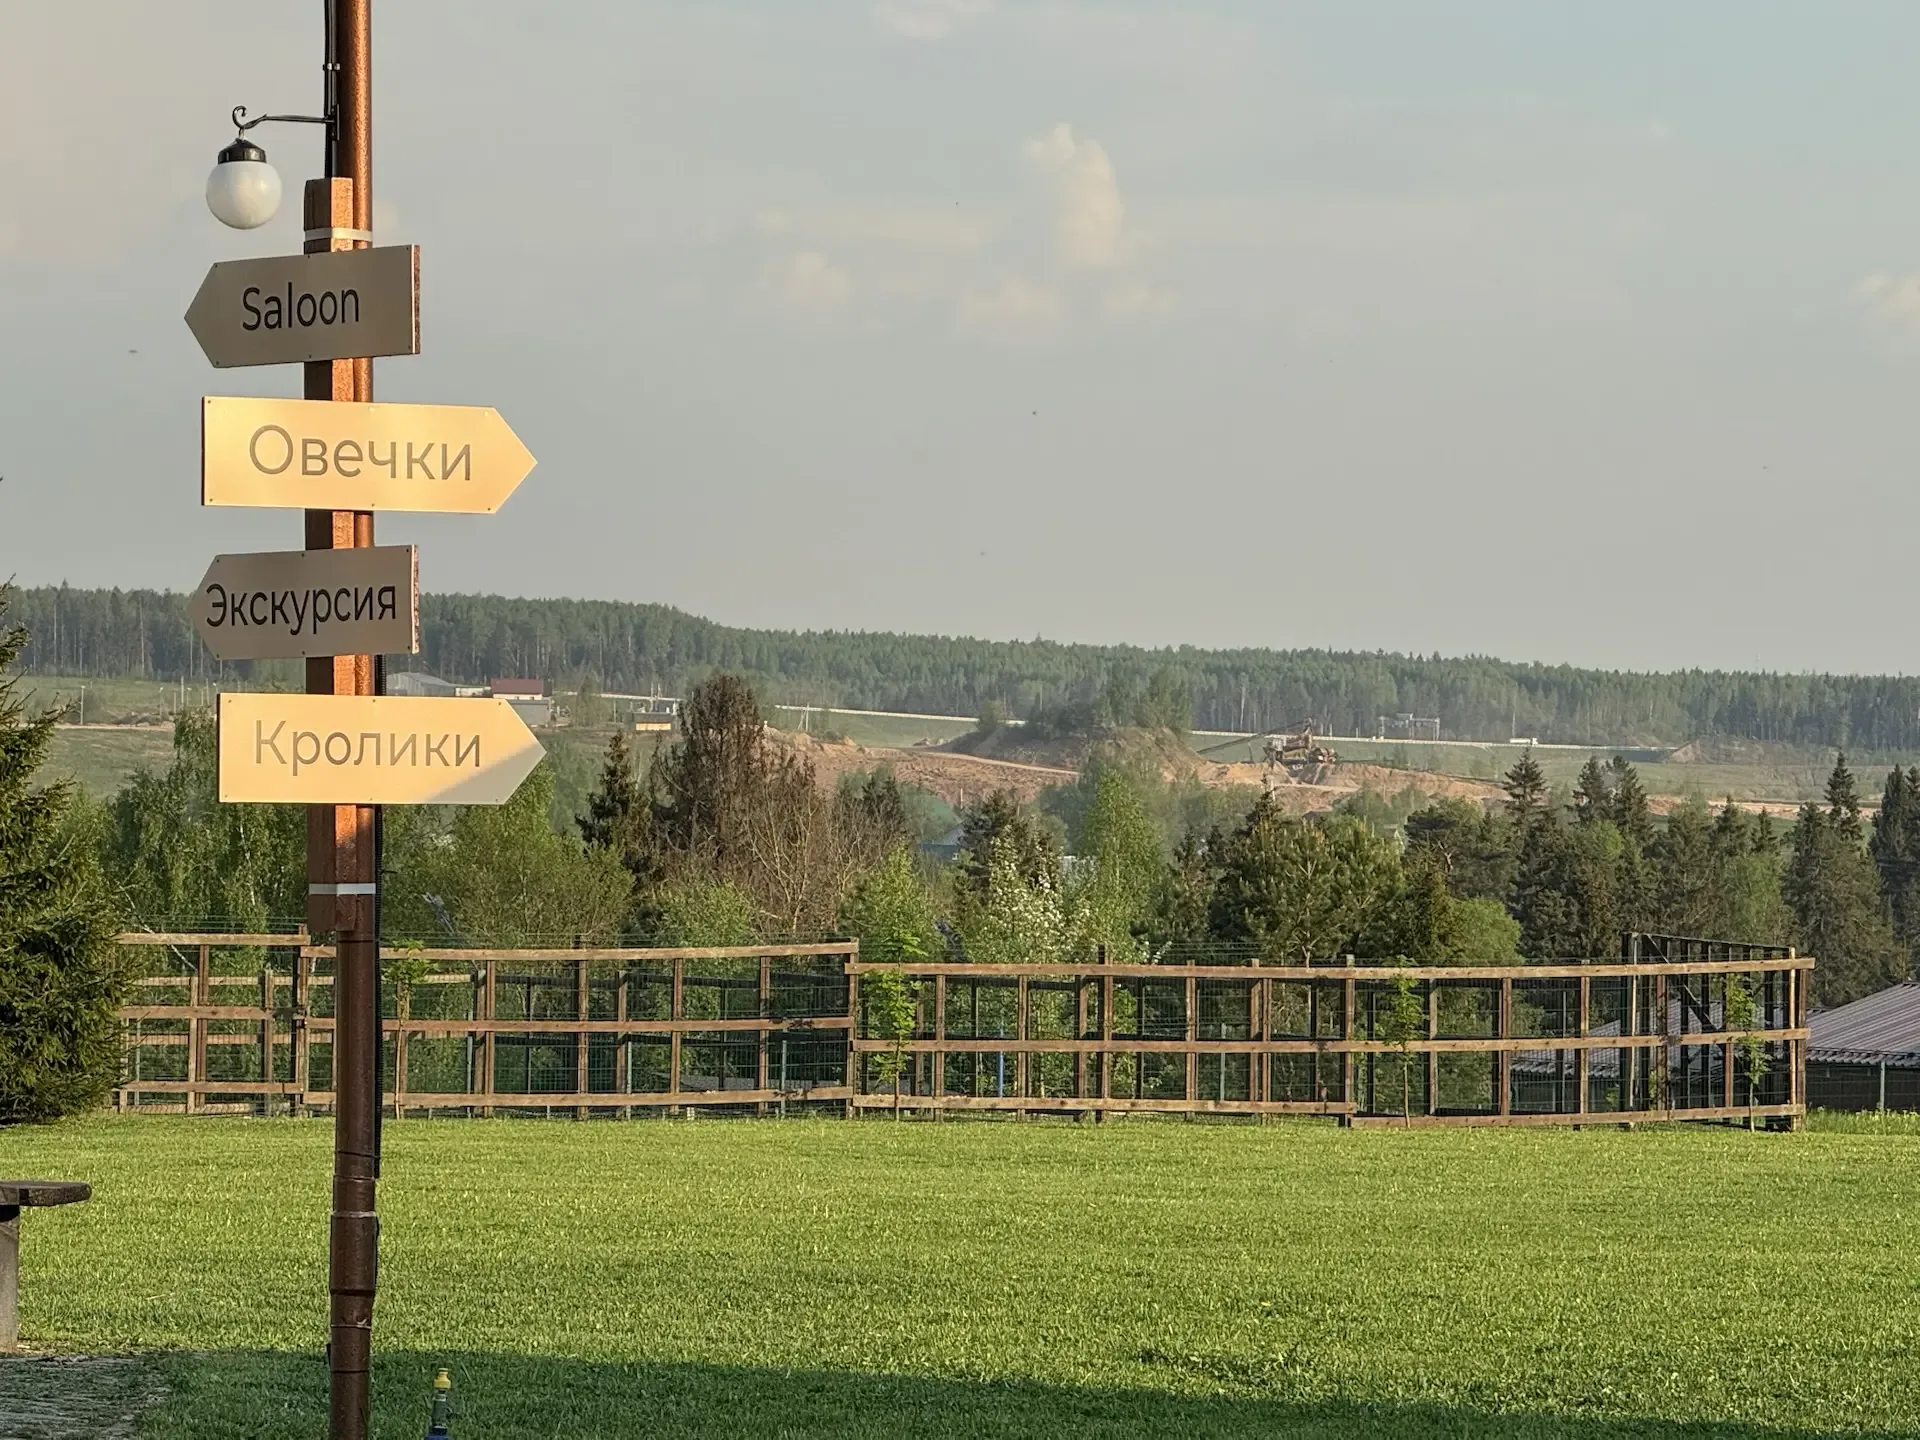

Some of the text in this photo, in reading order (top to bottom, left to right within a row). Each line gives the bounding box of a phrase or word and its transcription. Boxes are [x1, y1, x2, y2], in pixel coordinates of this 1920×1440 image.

[242, 282, 360, 331] Saloon
[249, 424, 471, 481] Овечки
[206, 583, 396, 636] Экскурсия
[255, 720, 481, 777] Кролики
